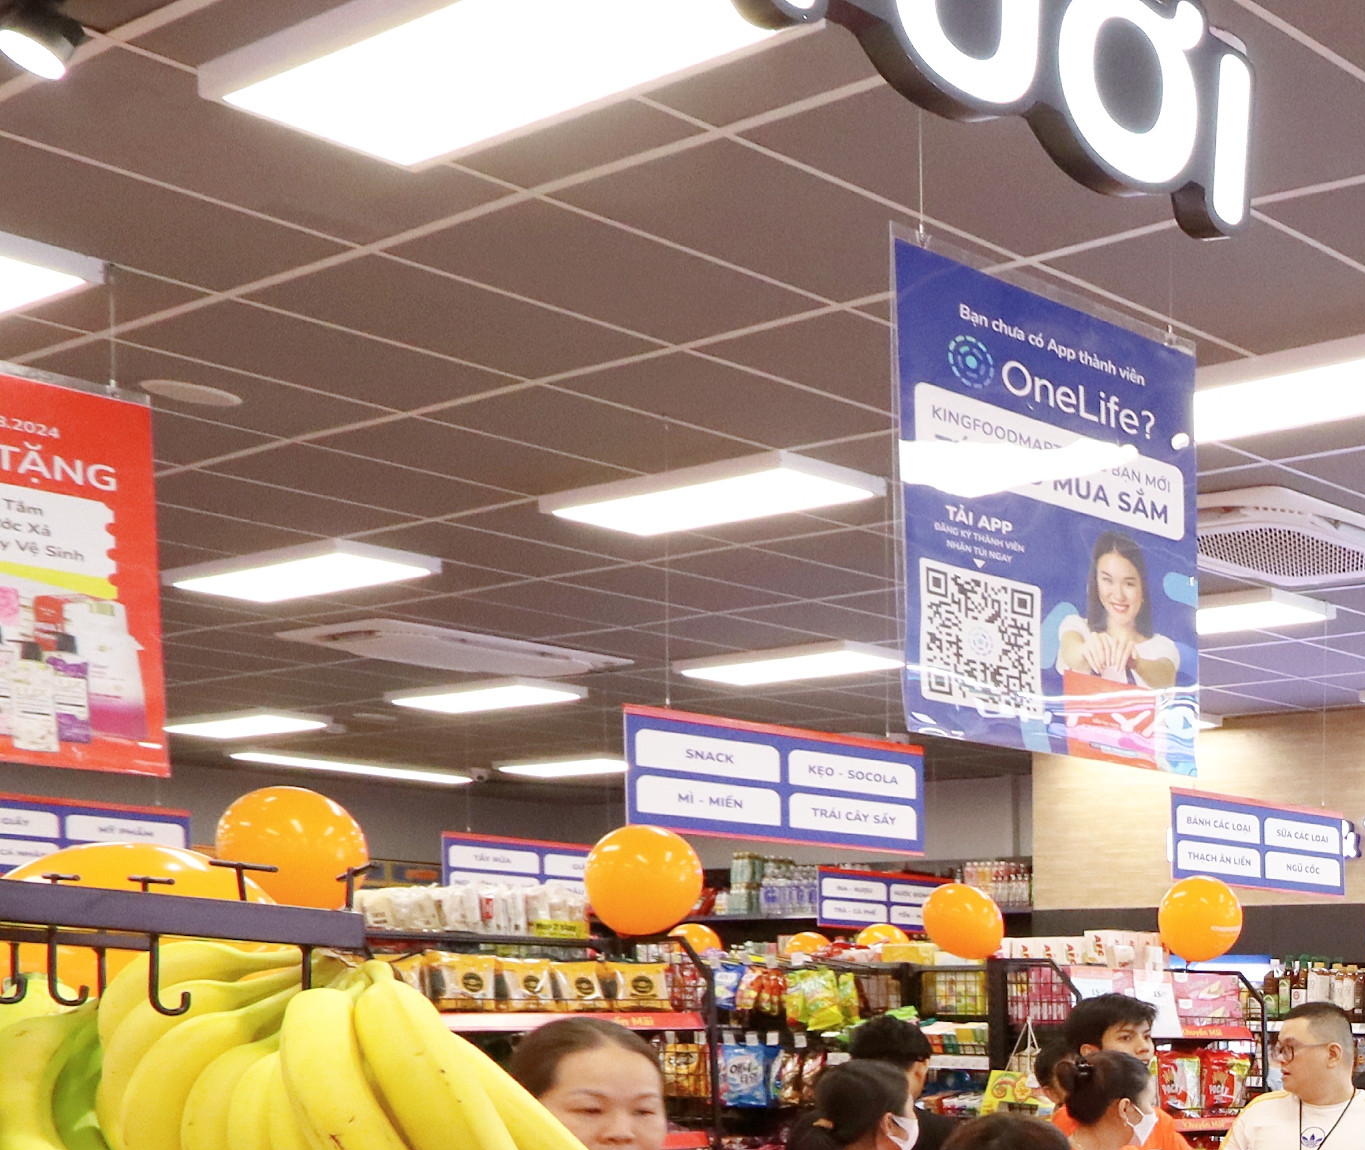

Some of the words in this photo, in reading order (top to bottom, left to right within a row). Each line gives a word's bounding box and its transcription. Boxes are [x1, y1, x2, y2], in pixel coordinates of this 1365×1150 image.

[959, 303, 988, 328] Bạn
[991, 317, 1025, 341] chưa
[1028, 332, 1044, 348] có
[1048, 338, 1076, 361] App
[1079, 351, 1116, 376] thành
[1119, 365, 1146, 386] viên
[1001, 359, 1155, 440] OneLife?
[1145, 472, 1171, 493] MỚI
[1053, 478, 1110, 507] MUA
[1118, 487, 1168, 524] SẮM
[978, 513, 1013, 534] APP
[45, 544, 85, 562] Sinh
[685, 748, 734, 765] SNACK
[808, 764, 834, 780] KẸO
[847, 770, 898, 786] SOCOLA
[678, 790, 694, 804] MÌ
[709, 792, 743, 810] MIẾN
[811, 806, 842, 821] TRÁI
[846, 807, 869, 824] CÂY
[872, 810, 897, 827] SẤY
[1187, 815, 1211, 828] BÁNH
[1214, 818, 1229, 831] CÁC
[1232, 823, 1251, 835] LOẠI
[1297, 829, 1310, 841] CÁC
[1312, 833, 1328, 845] LOẠI
[1188, 851, 1217, 864] THẠCH
[1219, 852, 1231, 864] ĂN
[1286, 862, 1302, 874] NGŨ
[1304, 862, 1320, 875] CỐC
